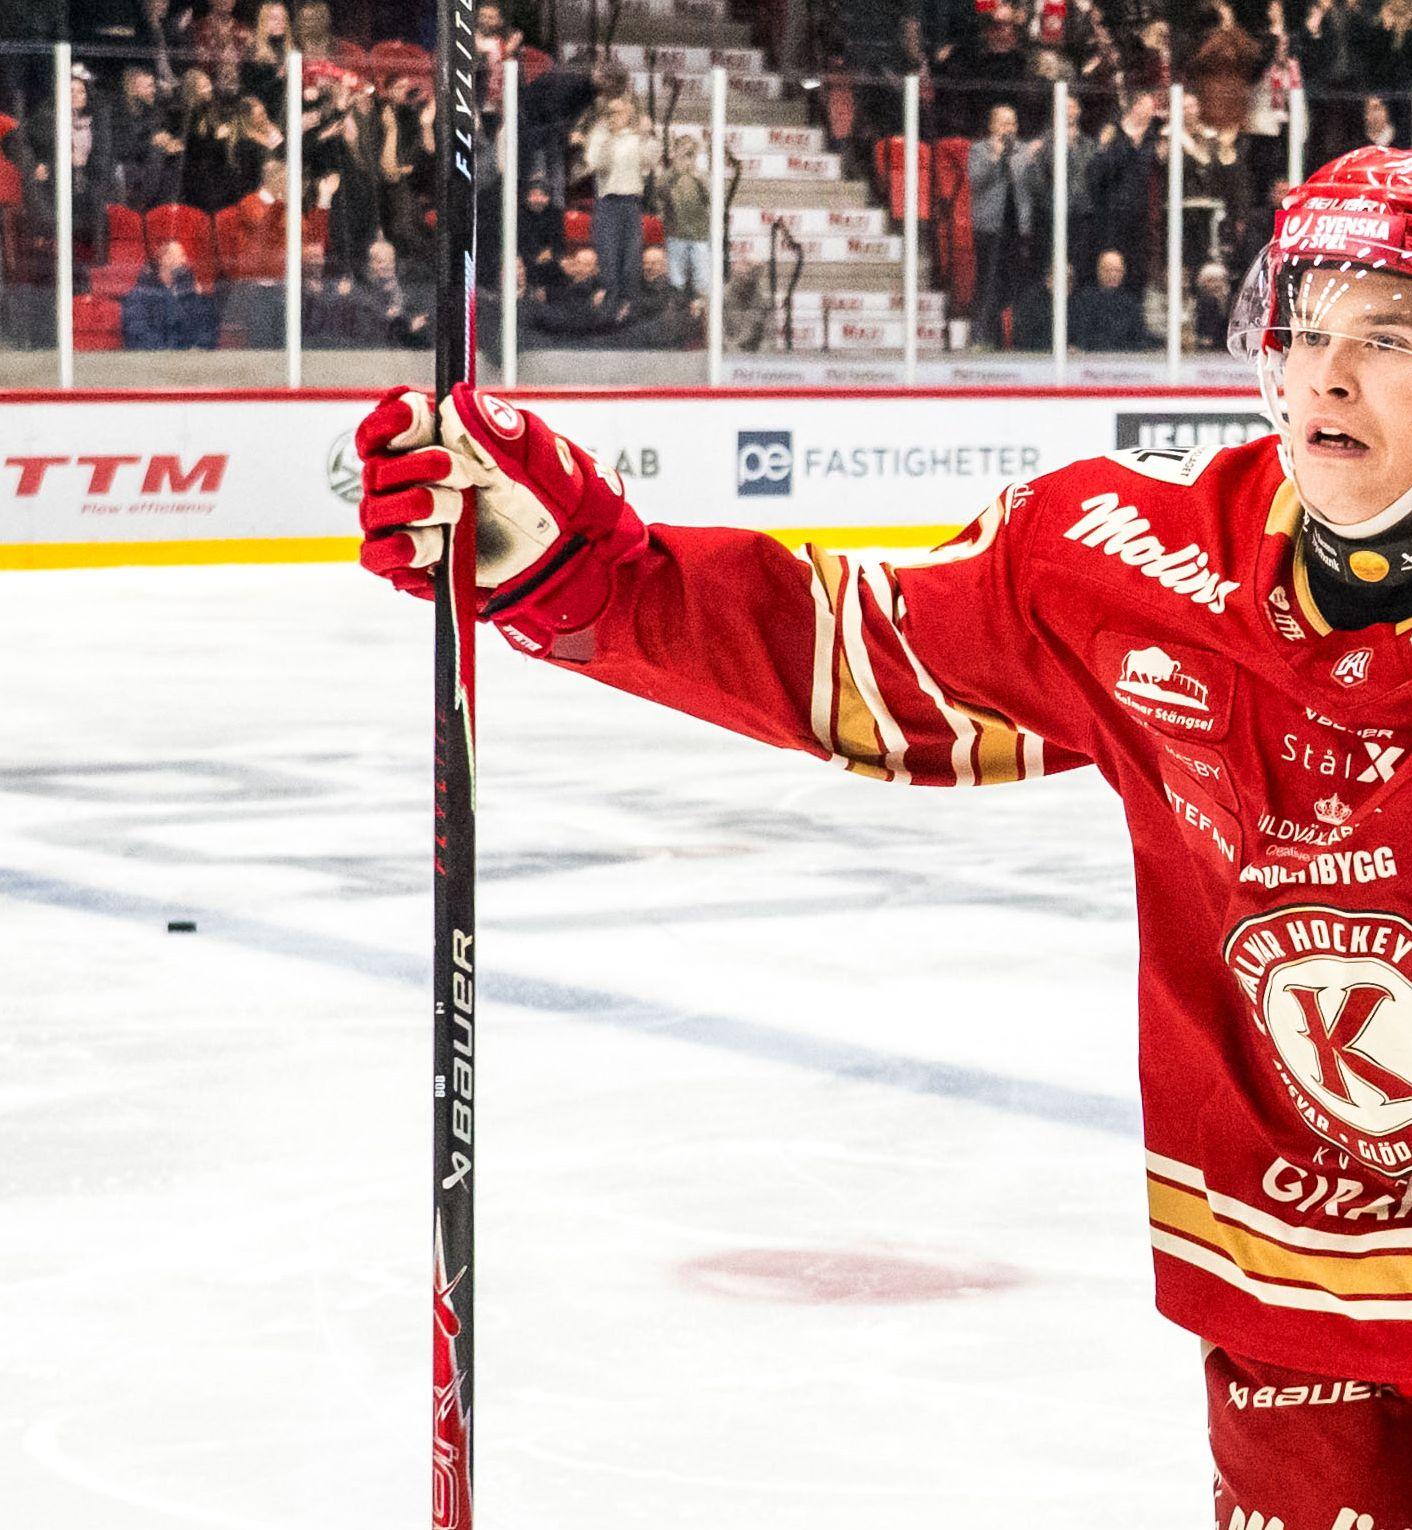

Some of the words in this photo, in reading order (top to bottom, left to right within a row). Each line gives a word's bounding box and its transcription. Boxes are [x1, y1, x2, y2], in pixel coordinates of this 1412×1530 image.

[1315, 215, 1389, 241] SVENSKA
[4, 453, 230, 497] TTM
[805, 446, 1041, 479] FASTIGHETER
[1063, 492, 1242, 615] Molins
[1155, 706, 1214, 732] Stängsel
[452, 928, 474, 1145] BAUER
[1357, 1138, 1412, 1167] GLÖD
